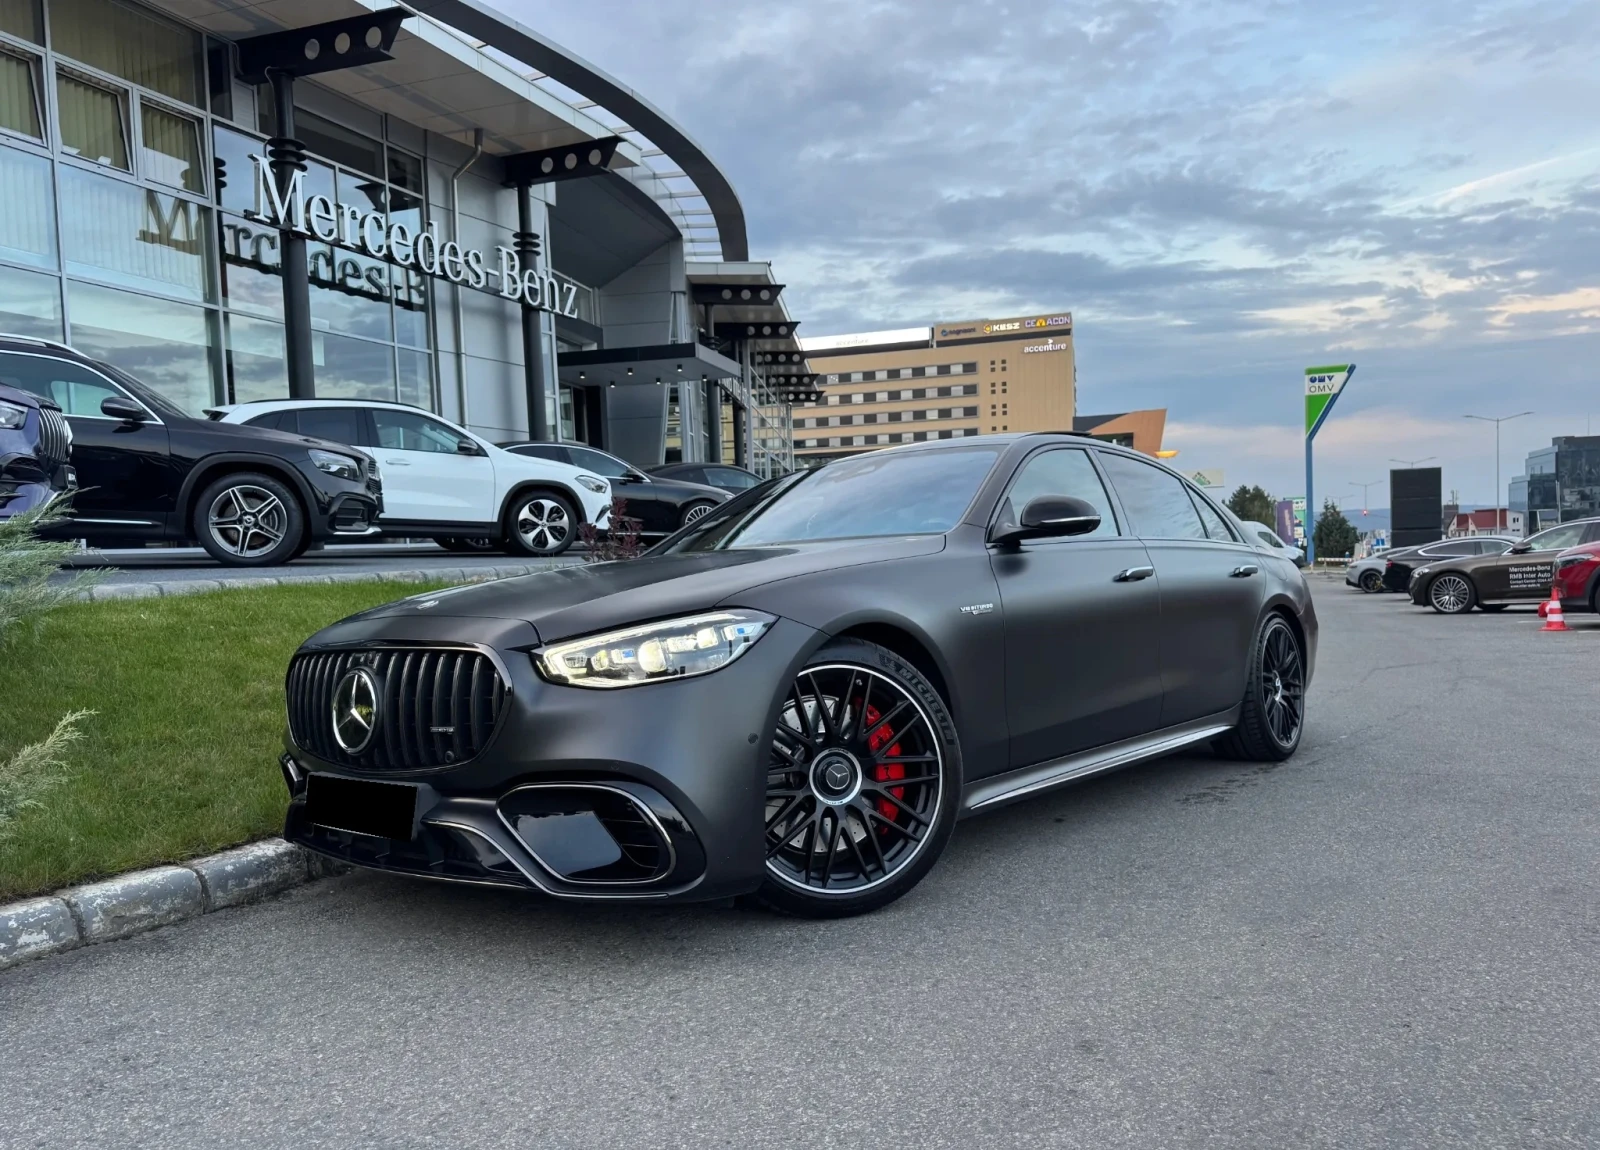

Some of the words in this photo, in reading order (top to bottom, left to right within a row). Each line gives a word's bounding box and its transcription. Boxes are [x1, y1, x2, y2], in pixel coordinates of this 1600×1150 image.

[248, 153, 578, 319] Mercedes-Benz
[1024, 341, 1066, 353] accenture
[1309, 384, 1334, 393] OMV
[899, 667, 954, 740] MICHELIN
